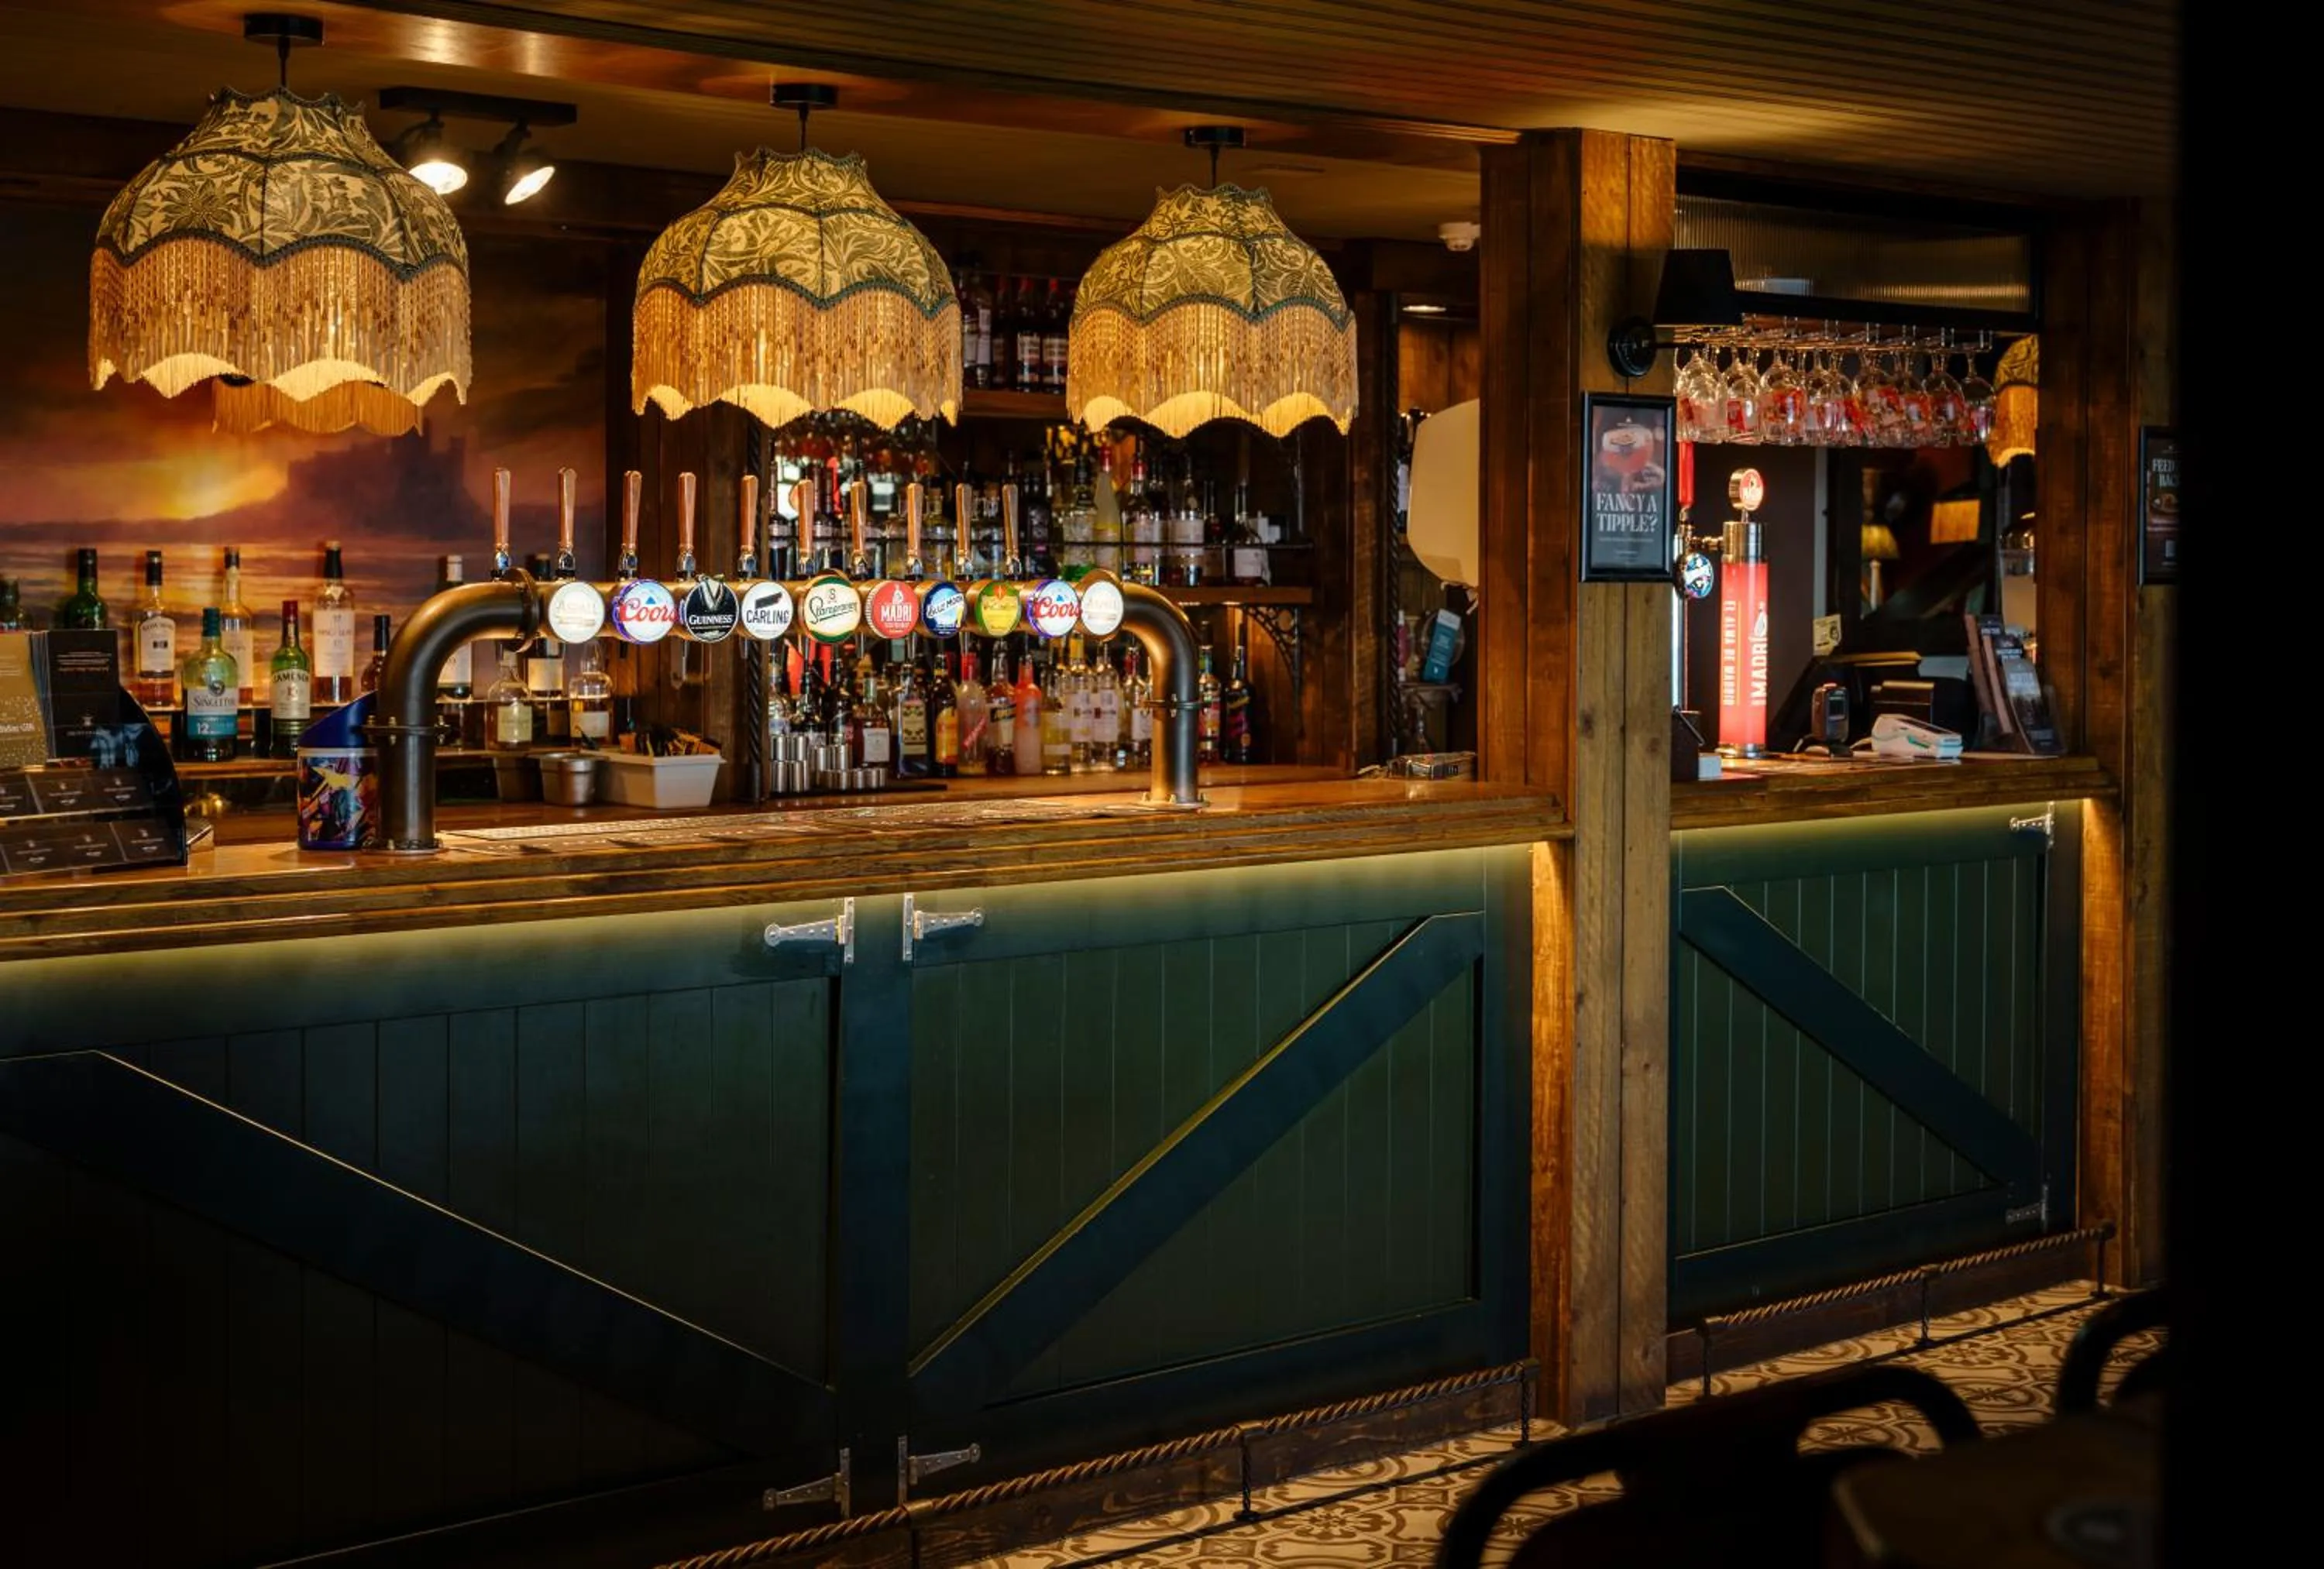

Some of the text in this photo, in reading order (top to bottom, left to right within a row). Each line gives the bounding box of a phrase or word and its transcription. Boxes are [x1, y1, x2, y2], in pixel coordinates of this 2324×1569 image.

[1597, 493, 1658, 512] FANCY A
[1597, 513, 1659, 533] TIPPLE?
[620, 590, 679, 623] Coors
[1033, 596, 1083, 618] Coors
[689, 614, 734, 626] GUINNESS
[746, 609, 789, 624] CARLING
[196, 721, 210, 735] 12
